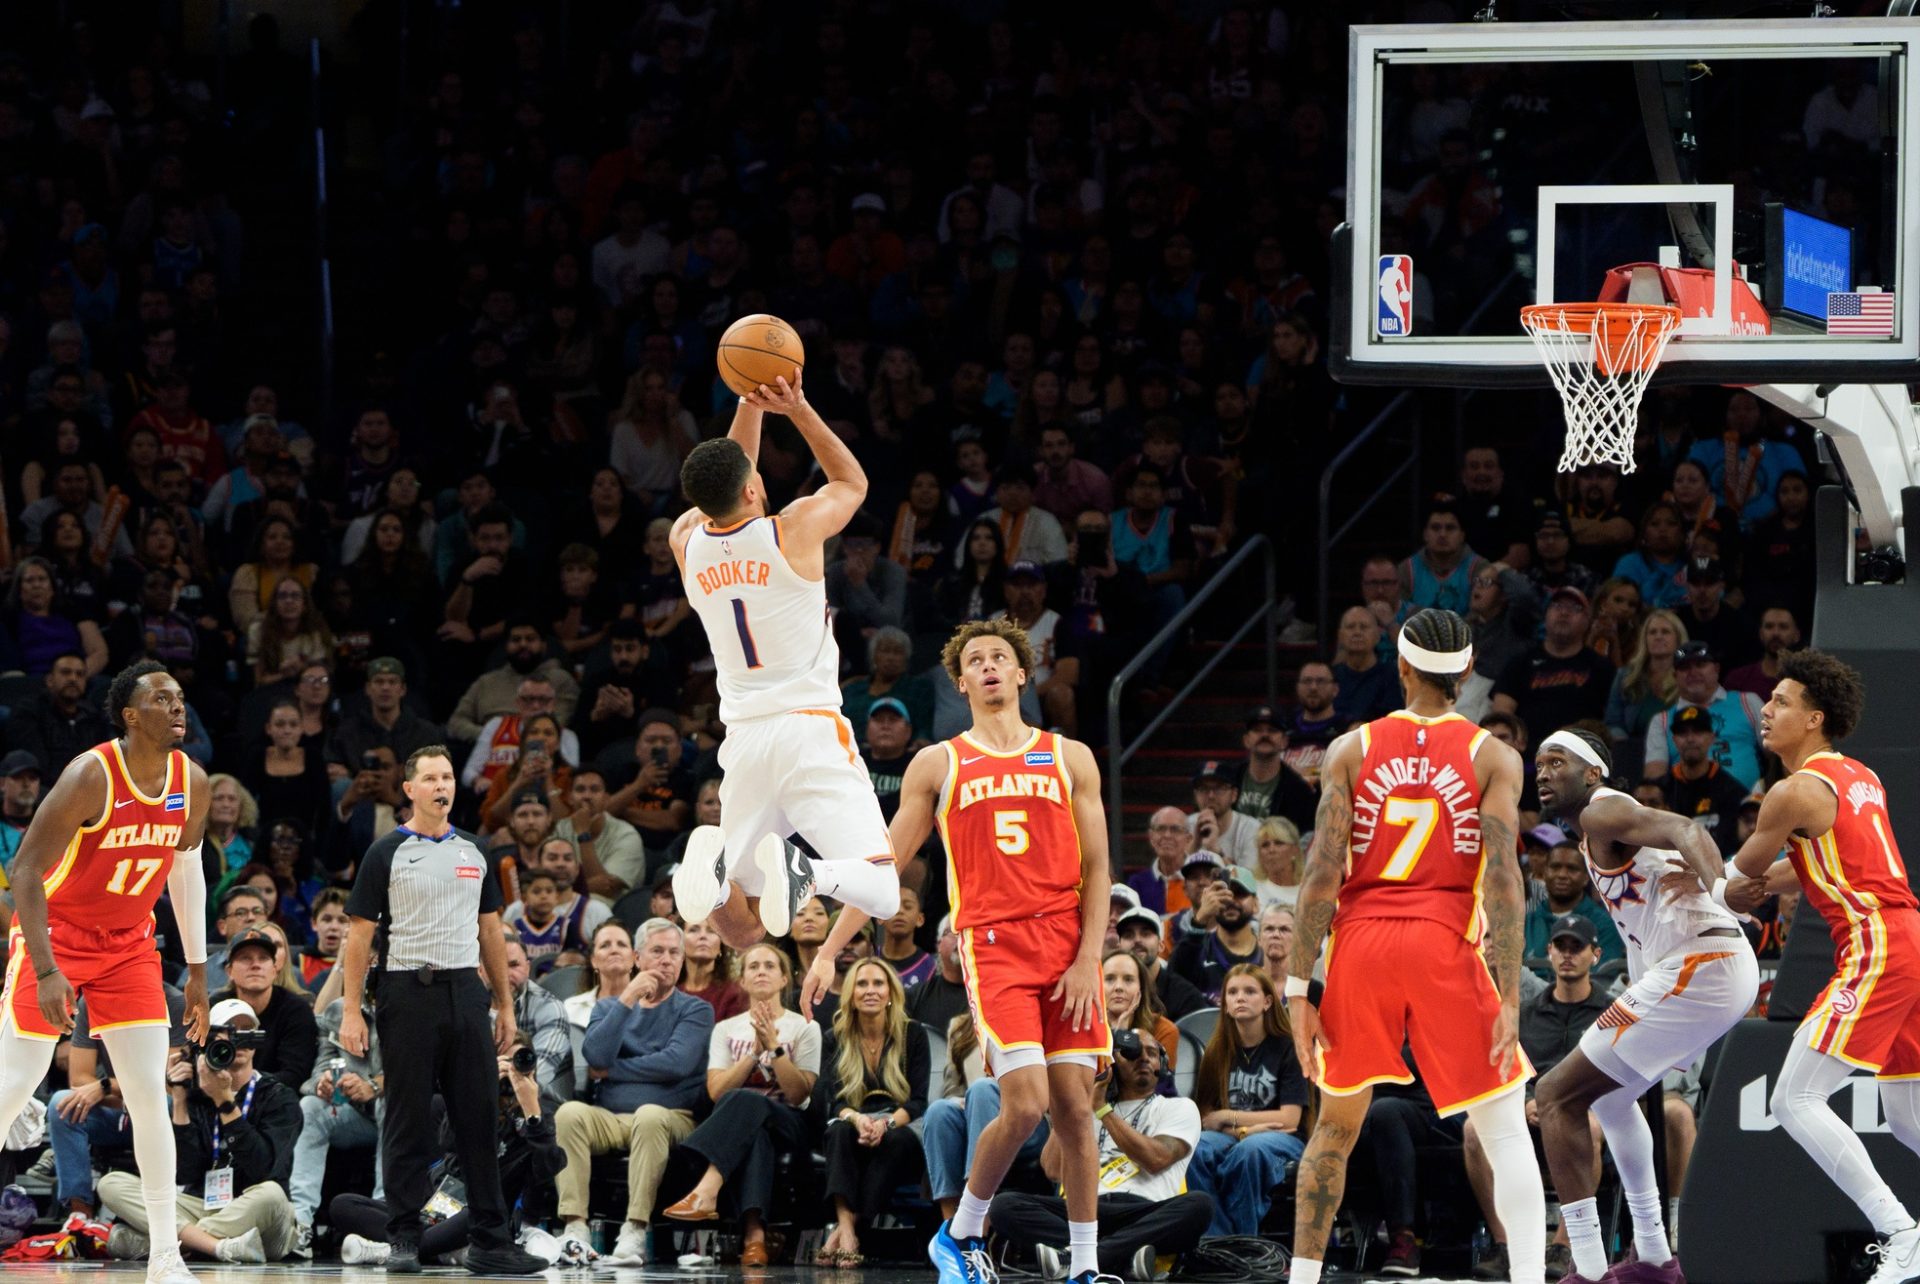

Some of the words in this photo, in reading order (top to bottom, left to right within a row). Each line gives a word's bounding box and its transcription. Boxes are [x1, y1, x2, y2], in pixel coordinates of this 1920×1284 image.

[1787, 241, 1846, 294] ticketmaster
[1381, 317, 1399, 331] NBA
[696, 560, 770, 596] BOOKER
[730, 598, 765, 671] 1
[1026, 754, 1052, 763] paze
[959, 773, 1062, 811] ATLANTA
[1352, 756, 1481, 854] ALEXANDER-WALKER
[994, 810, 1030, 856] 5
[1379, 796, 1440, 881] 7
[1871, 813, 1904, 878] 1
[106, 858, 164, 896] 17
